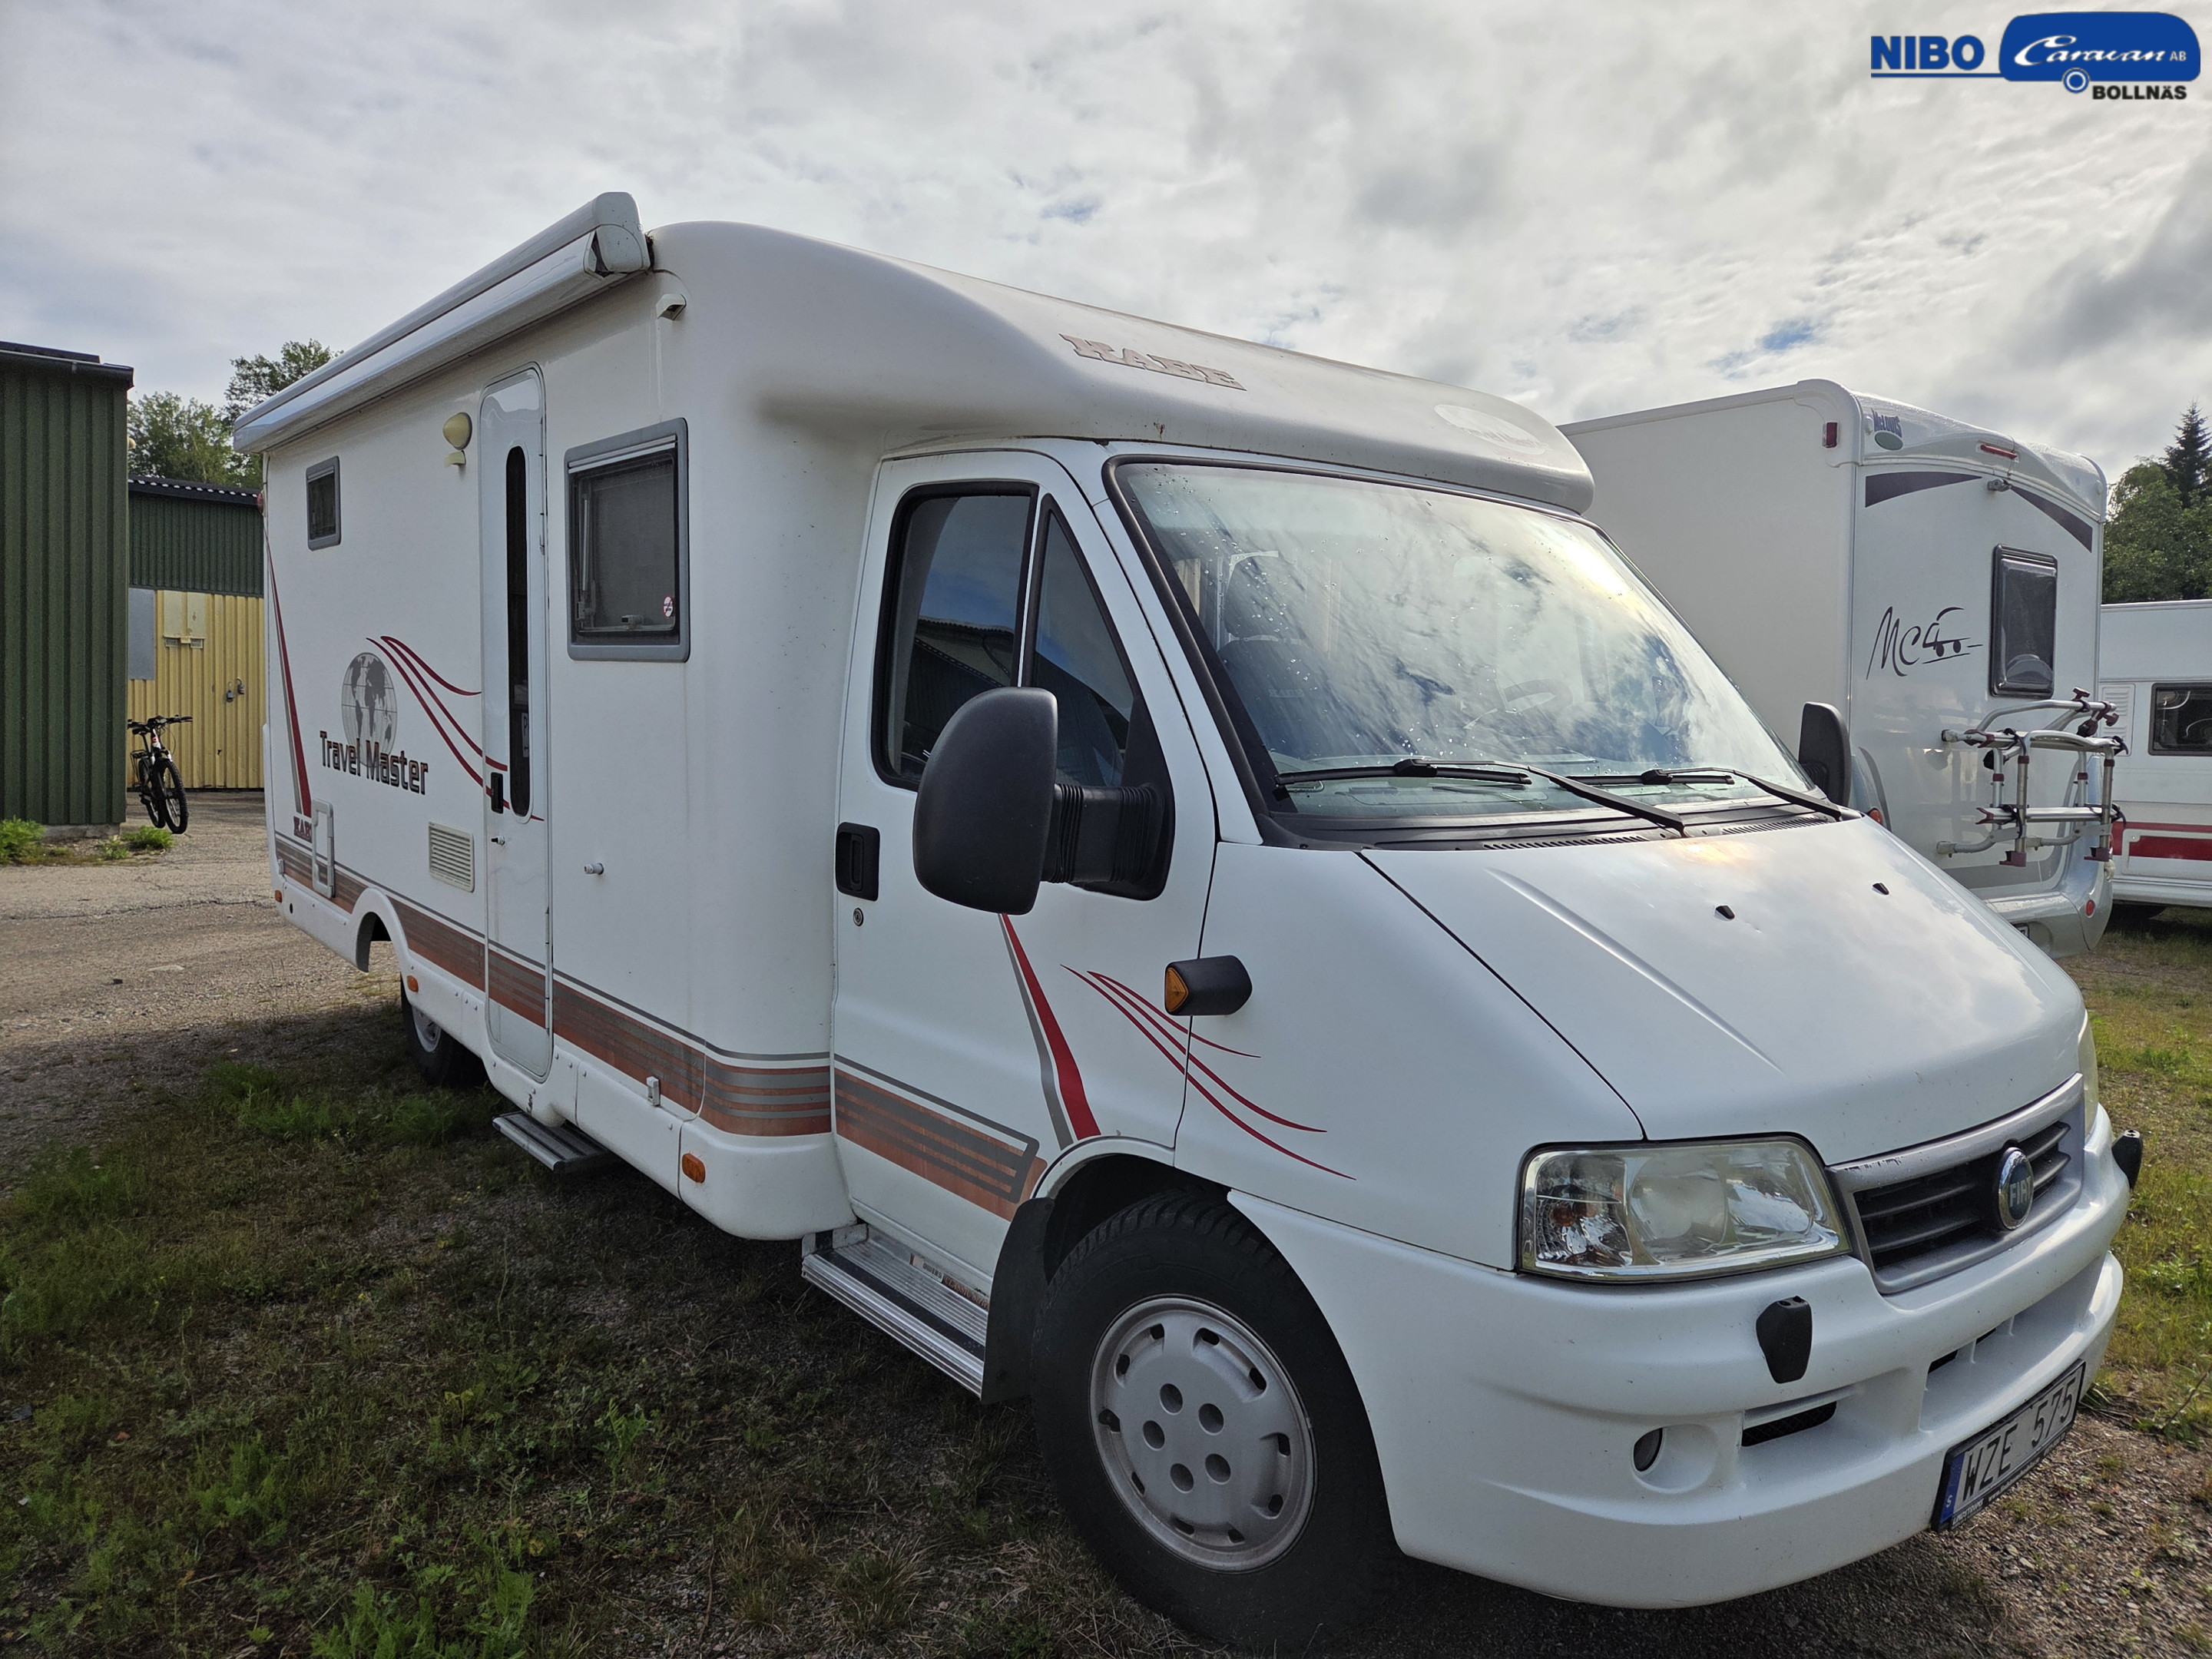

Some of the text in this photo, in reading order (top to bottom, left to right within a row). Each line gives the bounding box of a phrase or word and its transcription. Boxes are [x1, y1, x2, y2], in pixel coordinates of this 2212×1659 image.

[1058, 333, 1247, 391] KABE
[320, 730, 429, 795] Travel Master
[293, 816, 313, 843] KAB
[2009, 1175, 2032, 1207] FIAT
[1963, 1422, 2018, 1502] WZE
[2032, 1376, 2076, 1448] 575
[1945, 1494, 1953, 1508] S
